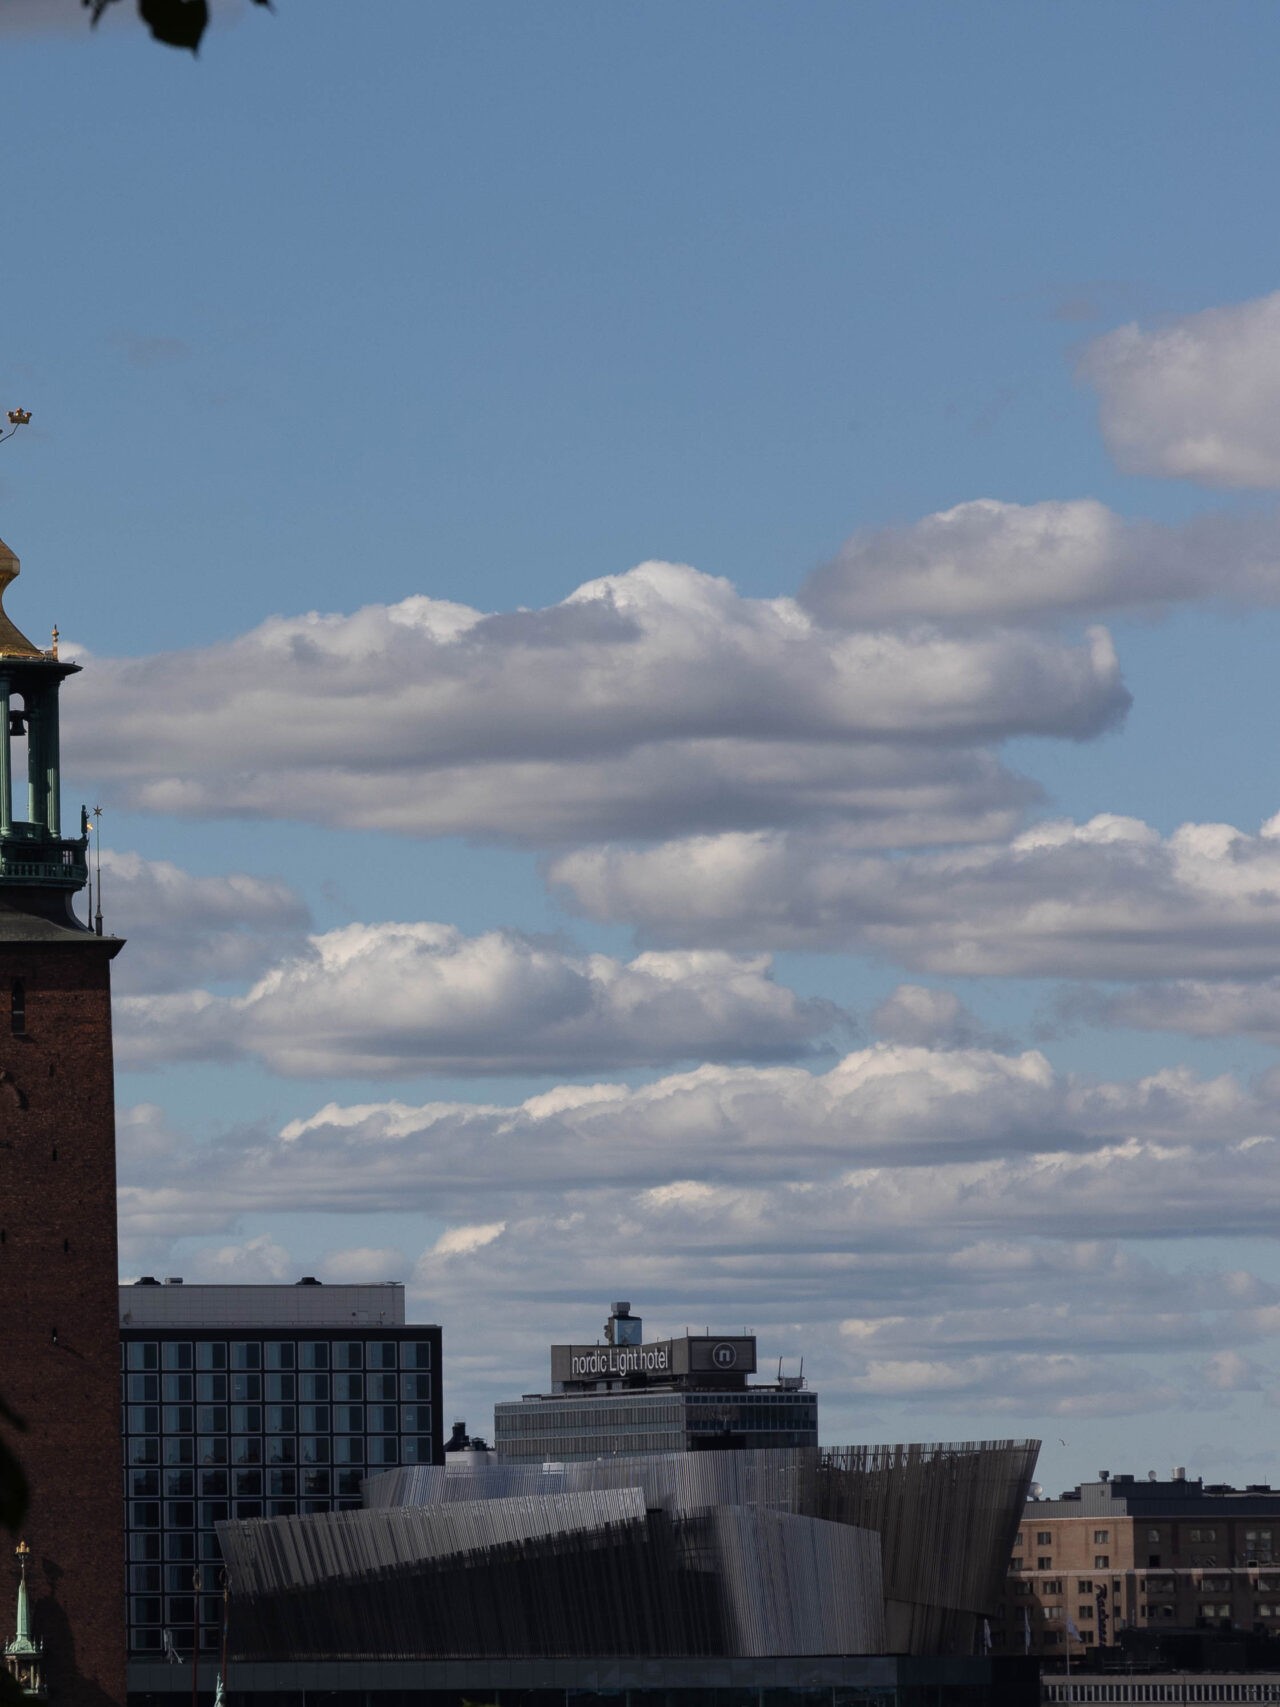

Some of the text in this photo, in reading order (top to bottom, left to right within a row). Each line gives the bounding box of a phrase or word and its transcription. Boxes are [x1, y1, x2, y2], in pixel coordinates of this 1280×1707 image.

[572, 1345, 668, 1376] nordic Light hotel
[719, 1350, 730, 1361] n
